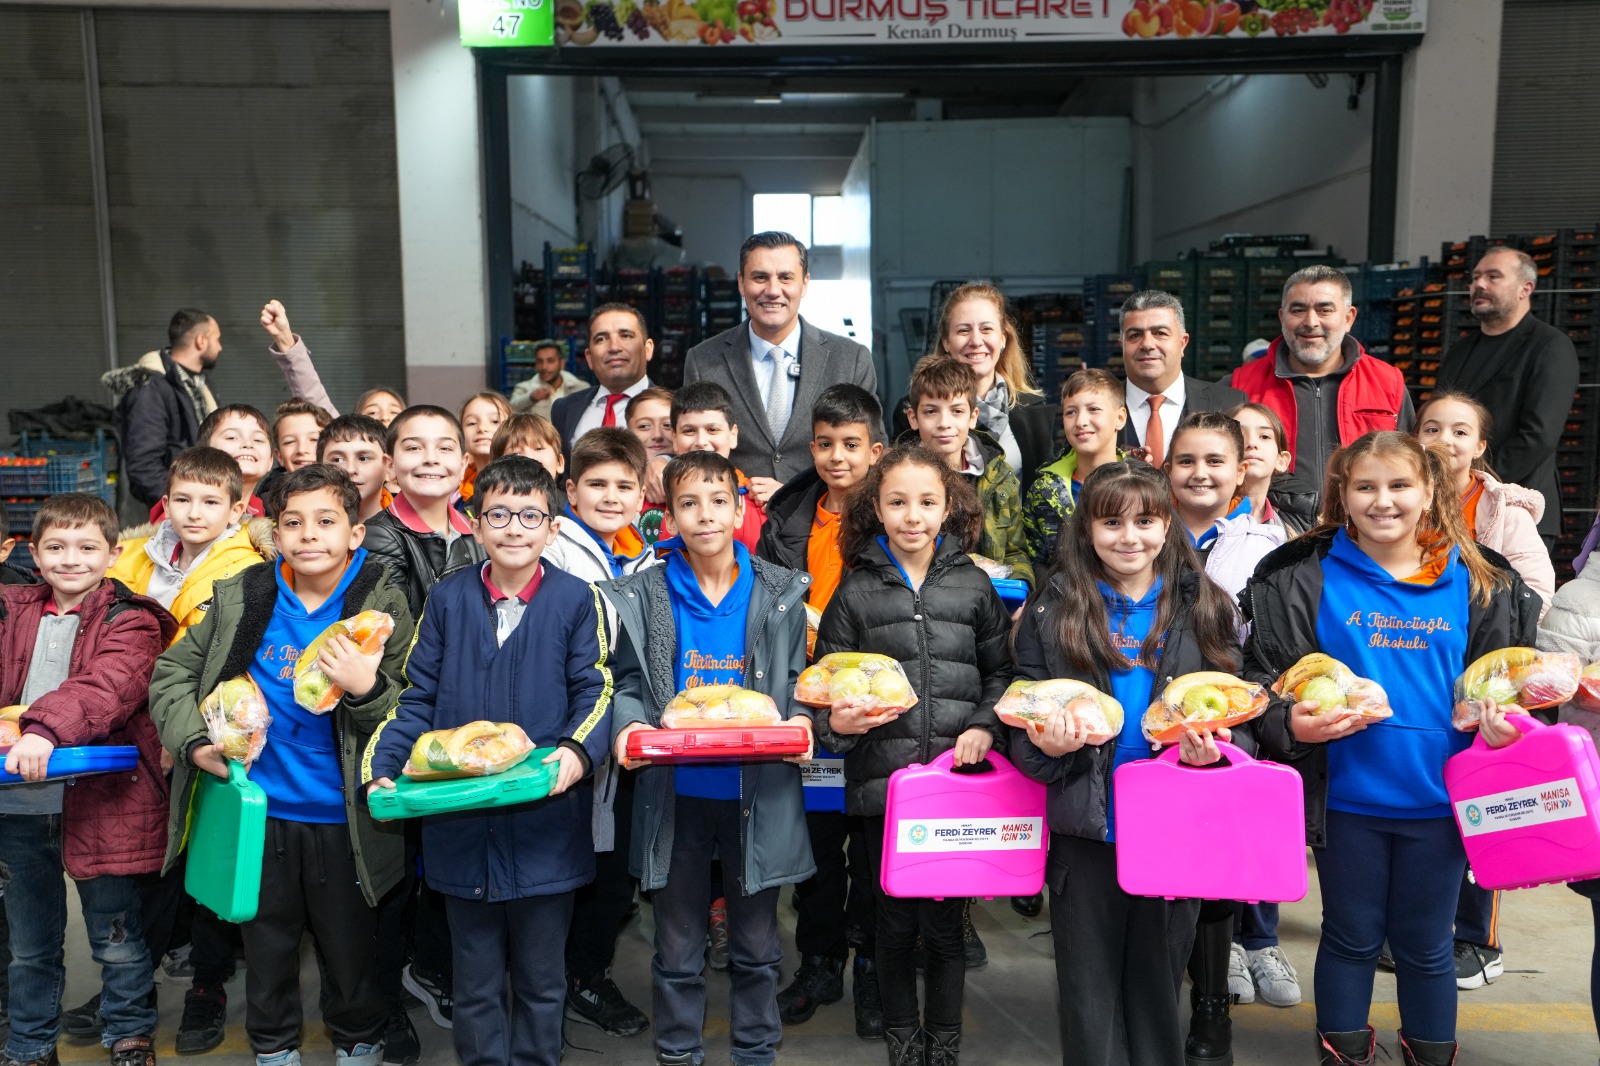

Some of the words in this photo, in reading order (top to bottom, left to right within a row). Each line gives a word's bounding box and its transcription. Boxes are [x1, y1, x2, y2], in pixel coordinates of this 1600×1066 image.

[492, 15, 520, 35] 47
[887, 24, 942, 40] Kenan
[948, 23, 1017, 41] Durmuş
[1346, 611, 1362, 626] A
[1368, 612, 1452, 634] Tütüncüoğlu
[262, 645, 274, 660] A
[1507, 797, 1539, 811] ZEYREK
[962, 827, 997, 836] ZEYREK
